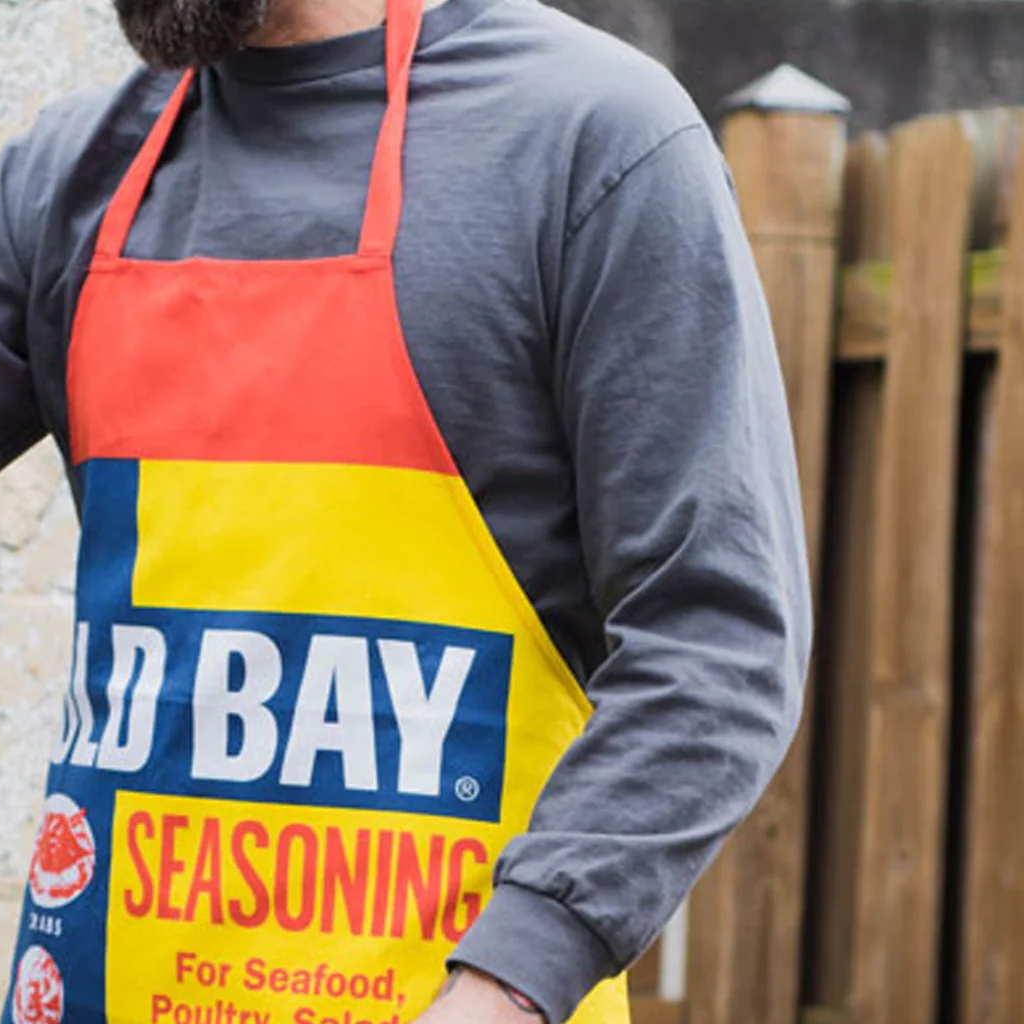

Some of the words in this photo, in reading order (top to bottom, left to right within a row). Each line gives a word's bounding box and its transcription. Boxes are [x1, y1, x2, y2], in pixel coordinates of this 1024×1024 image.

[191, 628, 476, 796] BAY
[124, 811, 489, 943] SEASONING
[175, 952, 232, 988] For
[243, 958, 406, 1007] Seafood,
